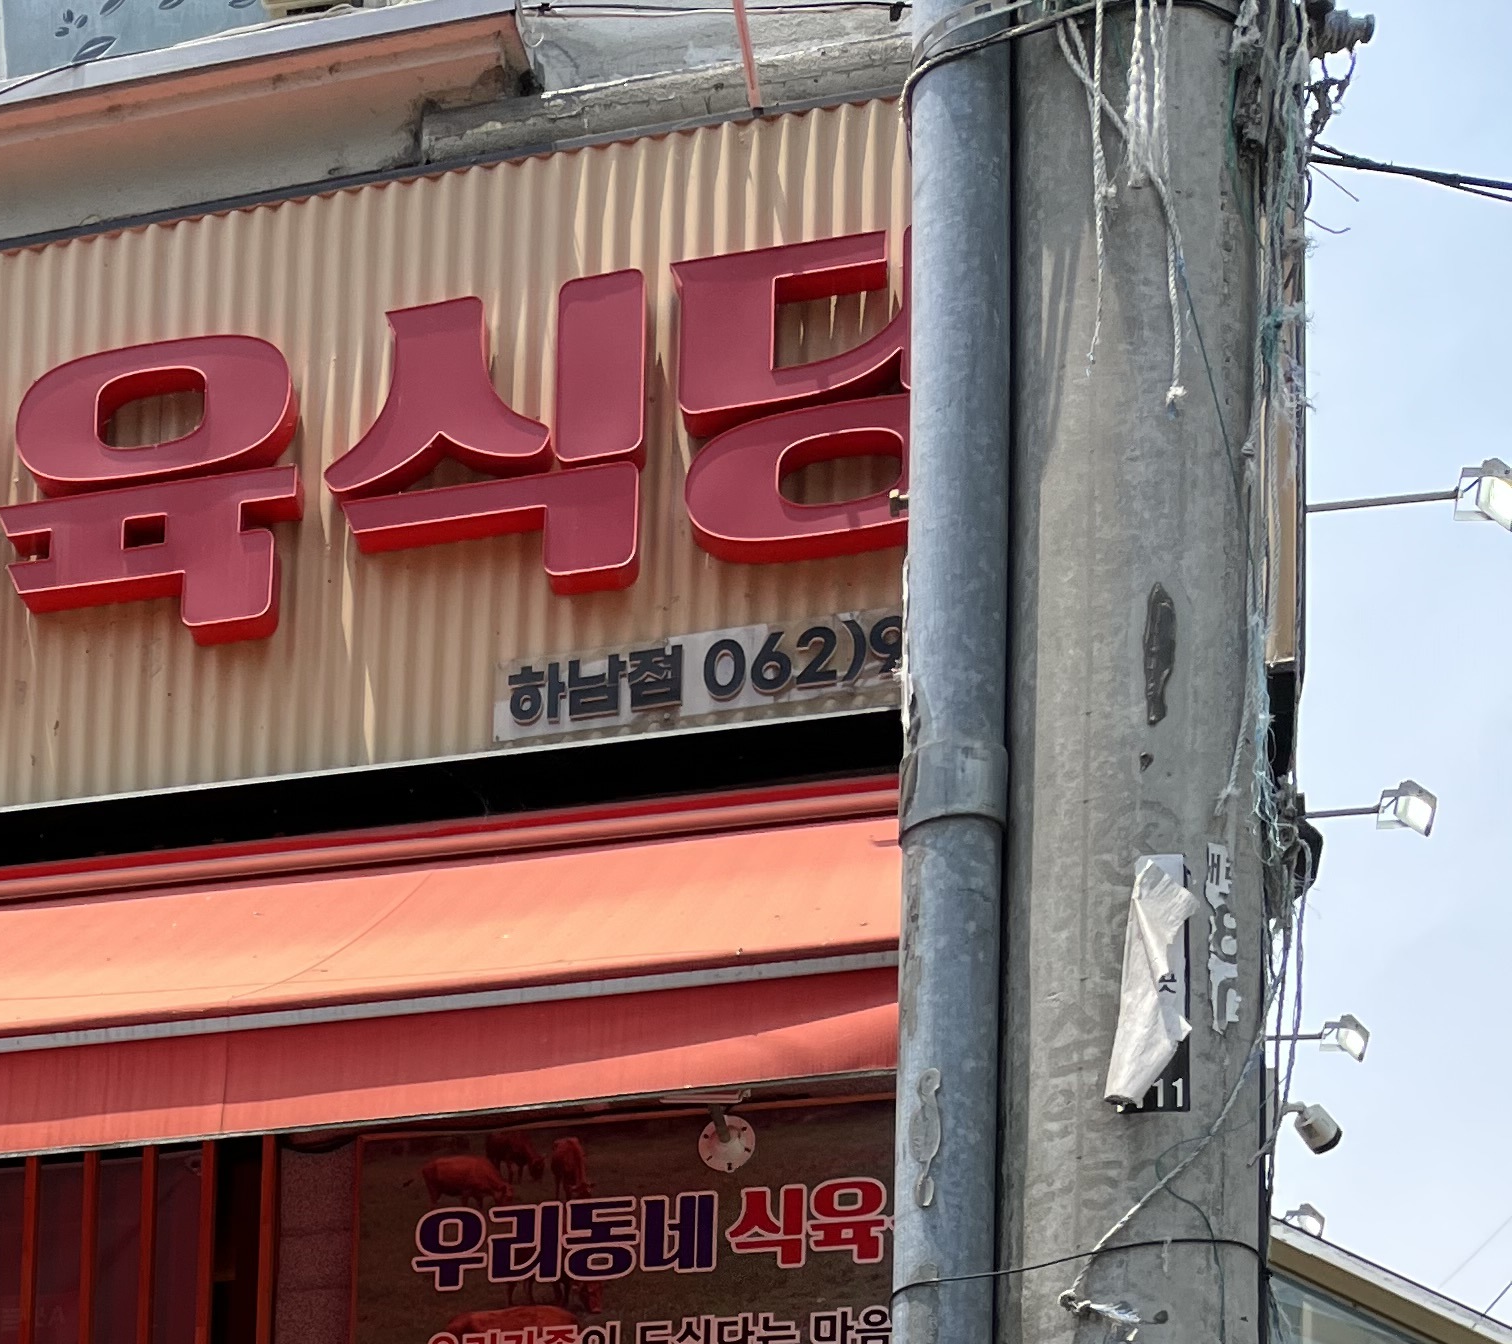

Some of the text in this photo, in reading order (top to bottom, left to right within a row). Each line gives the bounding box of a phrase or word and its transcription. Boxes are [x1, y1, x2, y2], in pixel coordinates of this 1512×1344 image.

[508, 644, 684, 725] 하남점
[412, 1177, 894, 1291] 우리동네 식육
